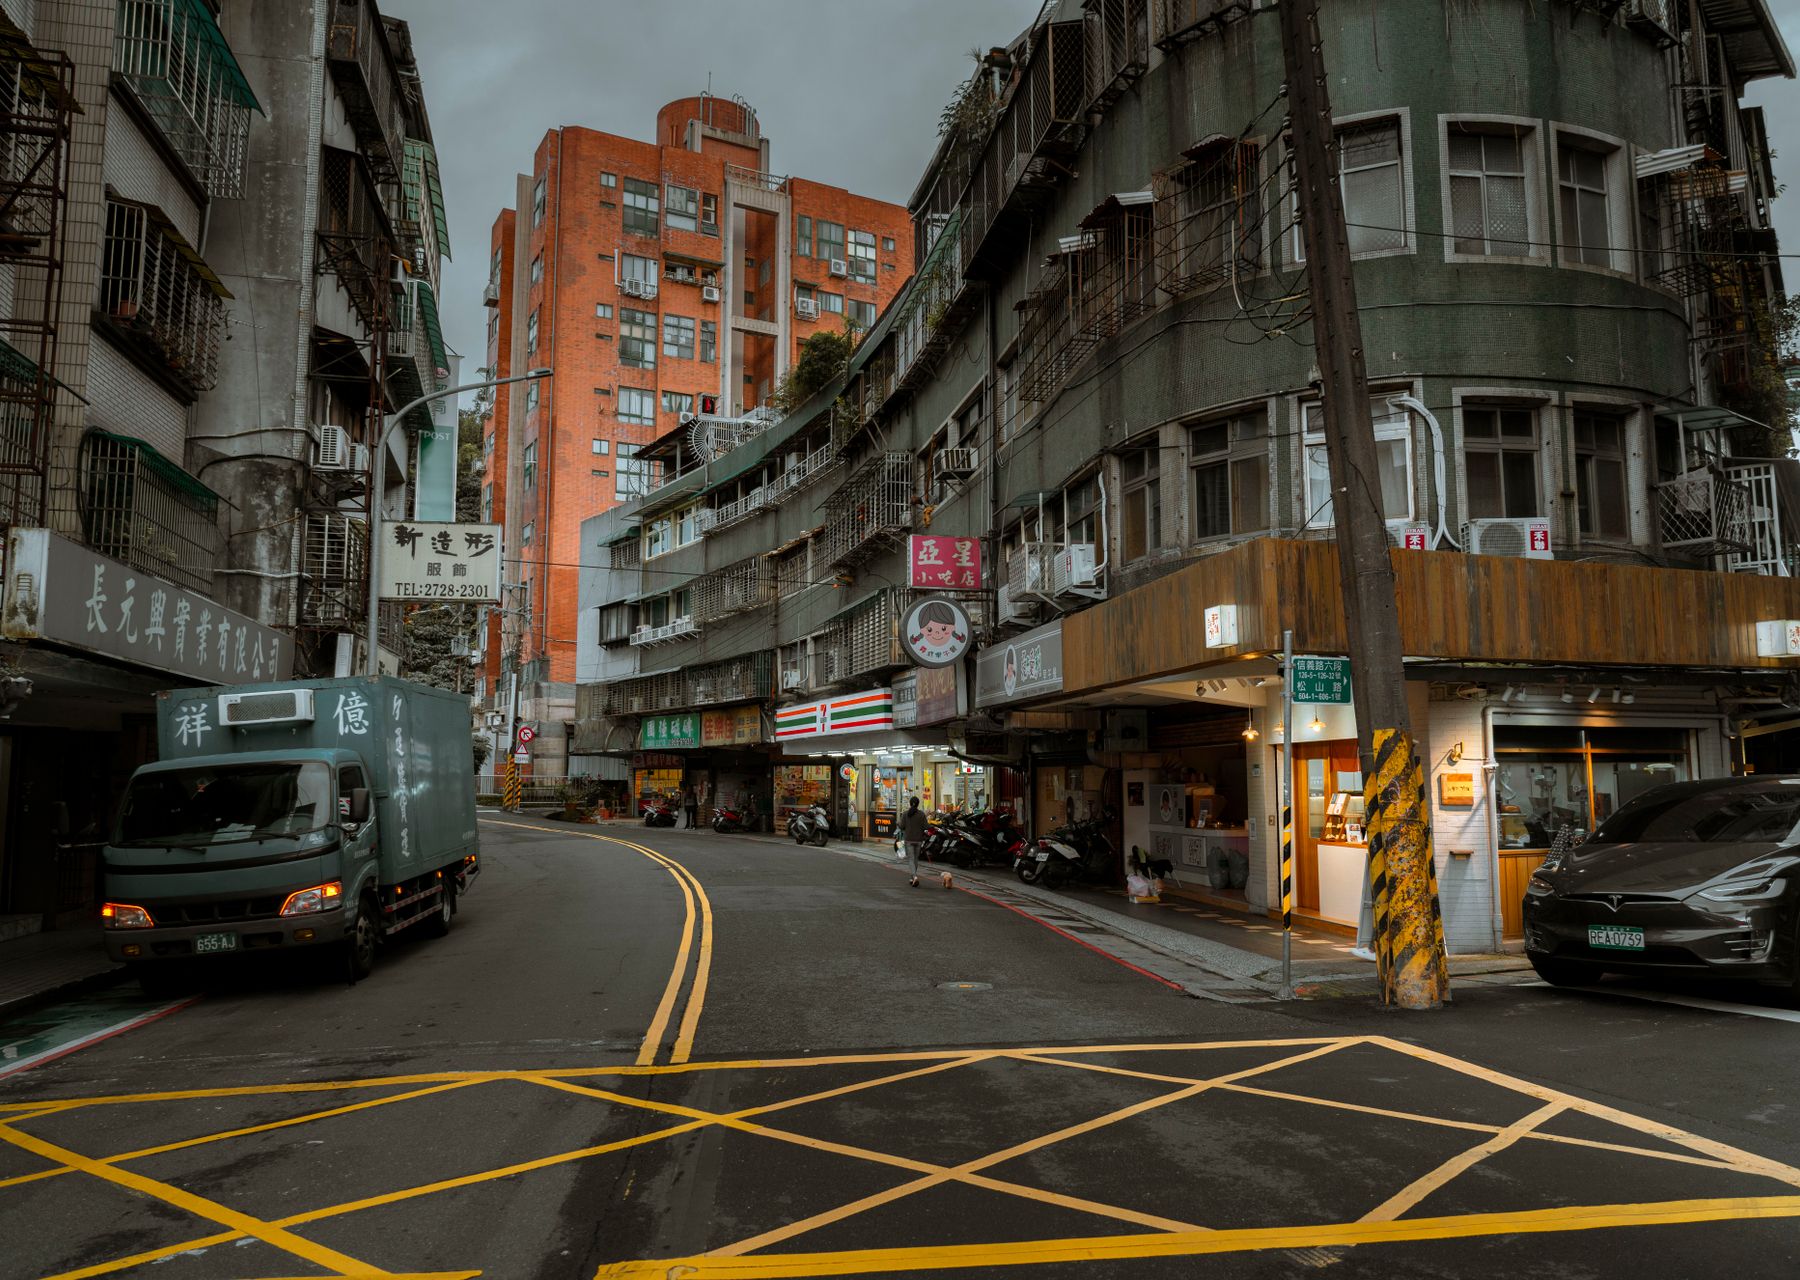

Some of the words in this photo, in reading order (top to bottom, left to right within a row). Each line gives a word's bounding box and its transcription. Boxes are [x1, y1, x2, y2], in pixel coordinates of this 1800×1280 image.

[423, 431, 451, 441] POST
[394, 524, 495, 560] 新造形
[917, 539, 975, 567] 亞星
[426, 562, 468, 577] 服飾
[916, 570, 975, 586] 小吃店
[85, 564, 280, 682] 長元興實業有限公司
[1297, 660, 1342, 672] 信義路六段
[1297, 681, 1342, 692] 松山路
[174, 703, 212, 748] 祥
[332, 691, 369, 736] 億
[196, 935, 236, 951] 655-AJ
[1590, 930, 1642, 947] REA-0739
